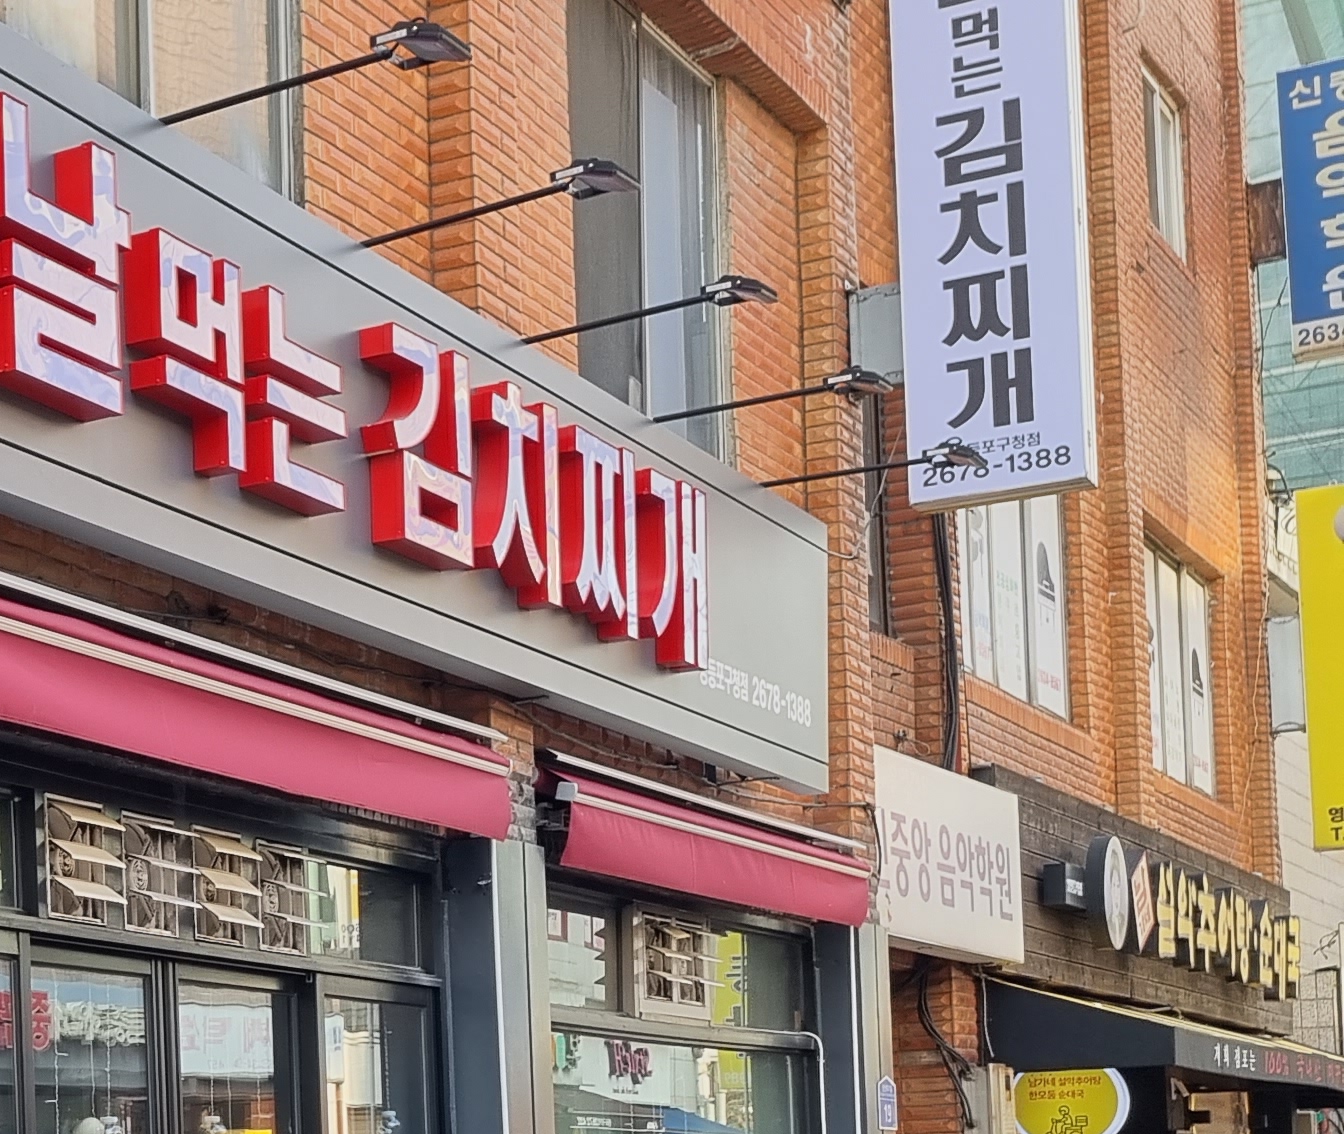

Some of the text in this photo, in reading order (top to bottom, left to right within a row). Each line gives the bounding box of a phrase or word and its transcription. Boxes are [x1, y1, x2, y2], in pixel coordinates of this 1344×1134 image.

[951, 9, 1004, 98] 먹는
[934, 97, 1036, 430] 김치찌개
[1298, 322, 1344, 348] 263
[123, 227, 347, 517] 먹는
[359, 322, 709, 671] 김치찌개
[752, 676, 811, 728] 2678-1388
[936, 824, 1013, 922] 음악학원
